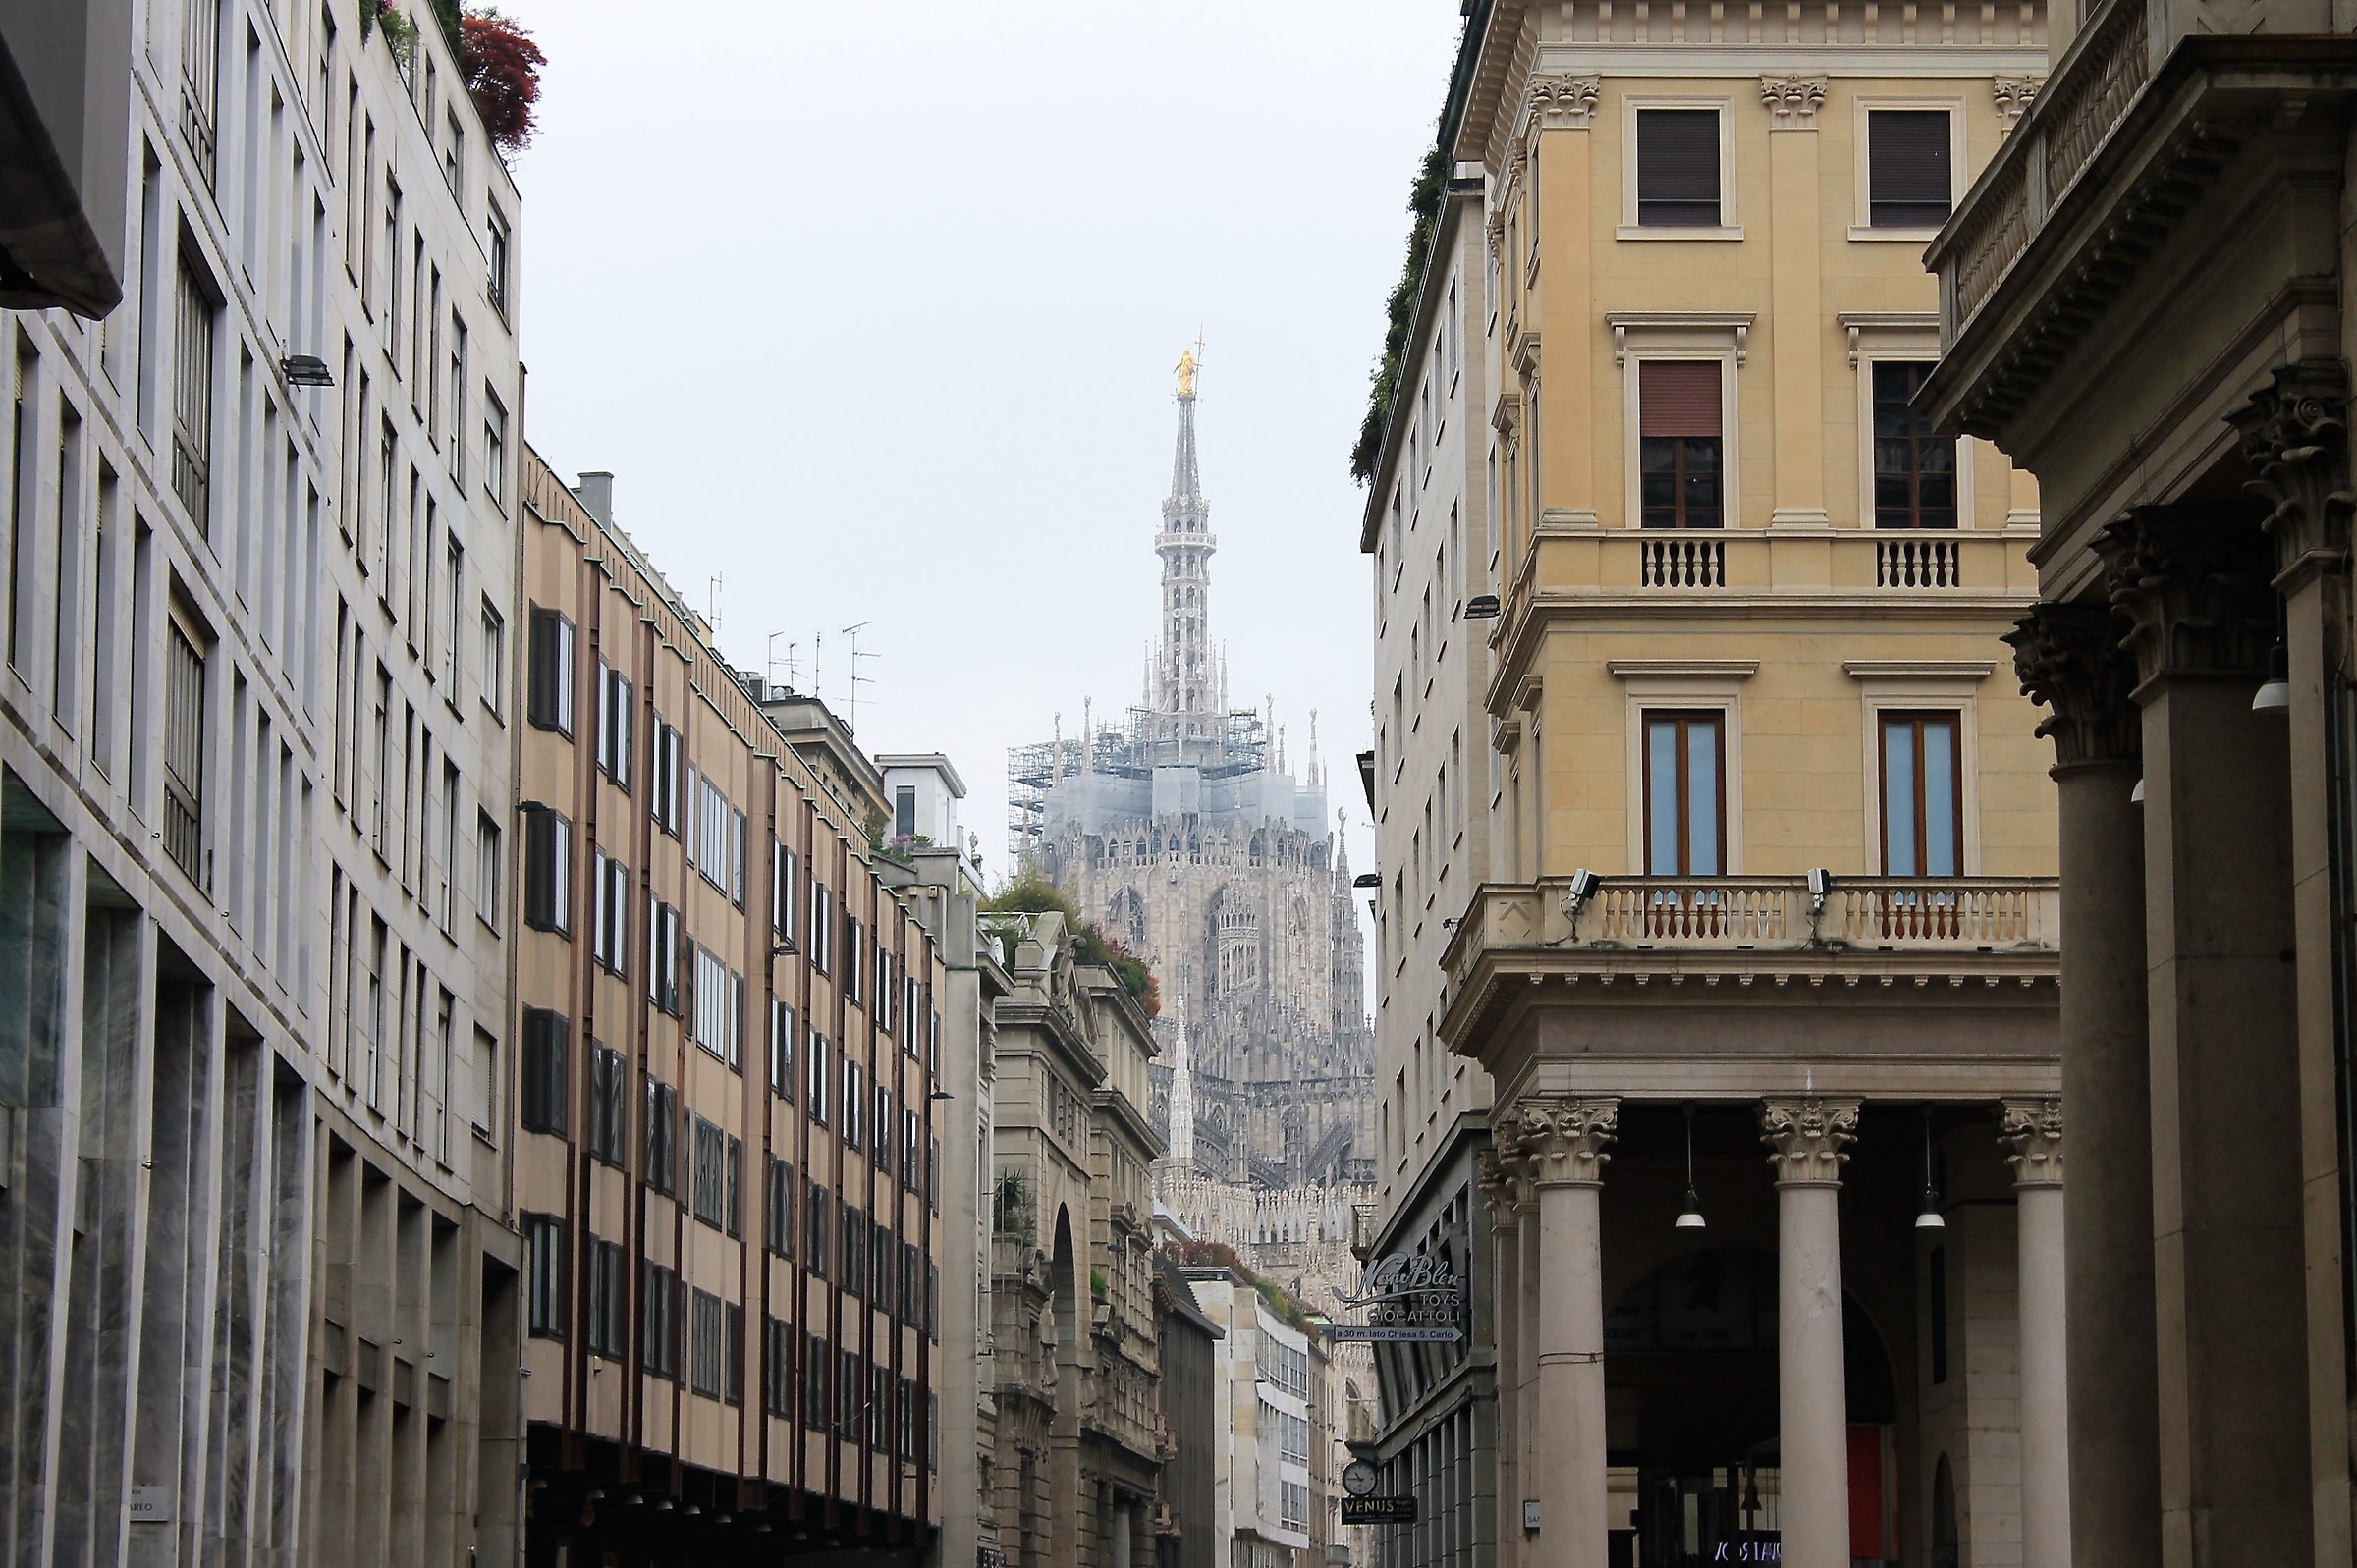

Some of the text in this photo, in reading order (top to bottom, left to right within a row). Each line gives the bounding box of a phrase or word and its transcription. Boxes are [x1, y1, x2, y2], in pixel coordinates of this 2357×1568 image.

[1420, 1295, 1460, 1307] TOYS
[1367, 1309, 1461, 1323] GIOCATTOLI
[1344, 1500, 1394, 1512] VENUS
